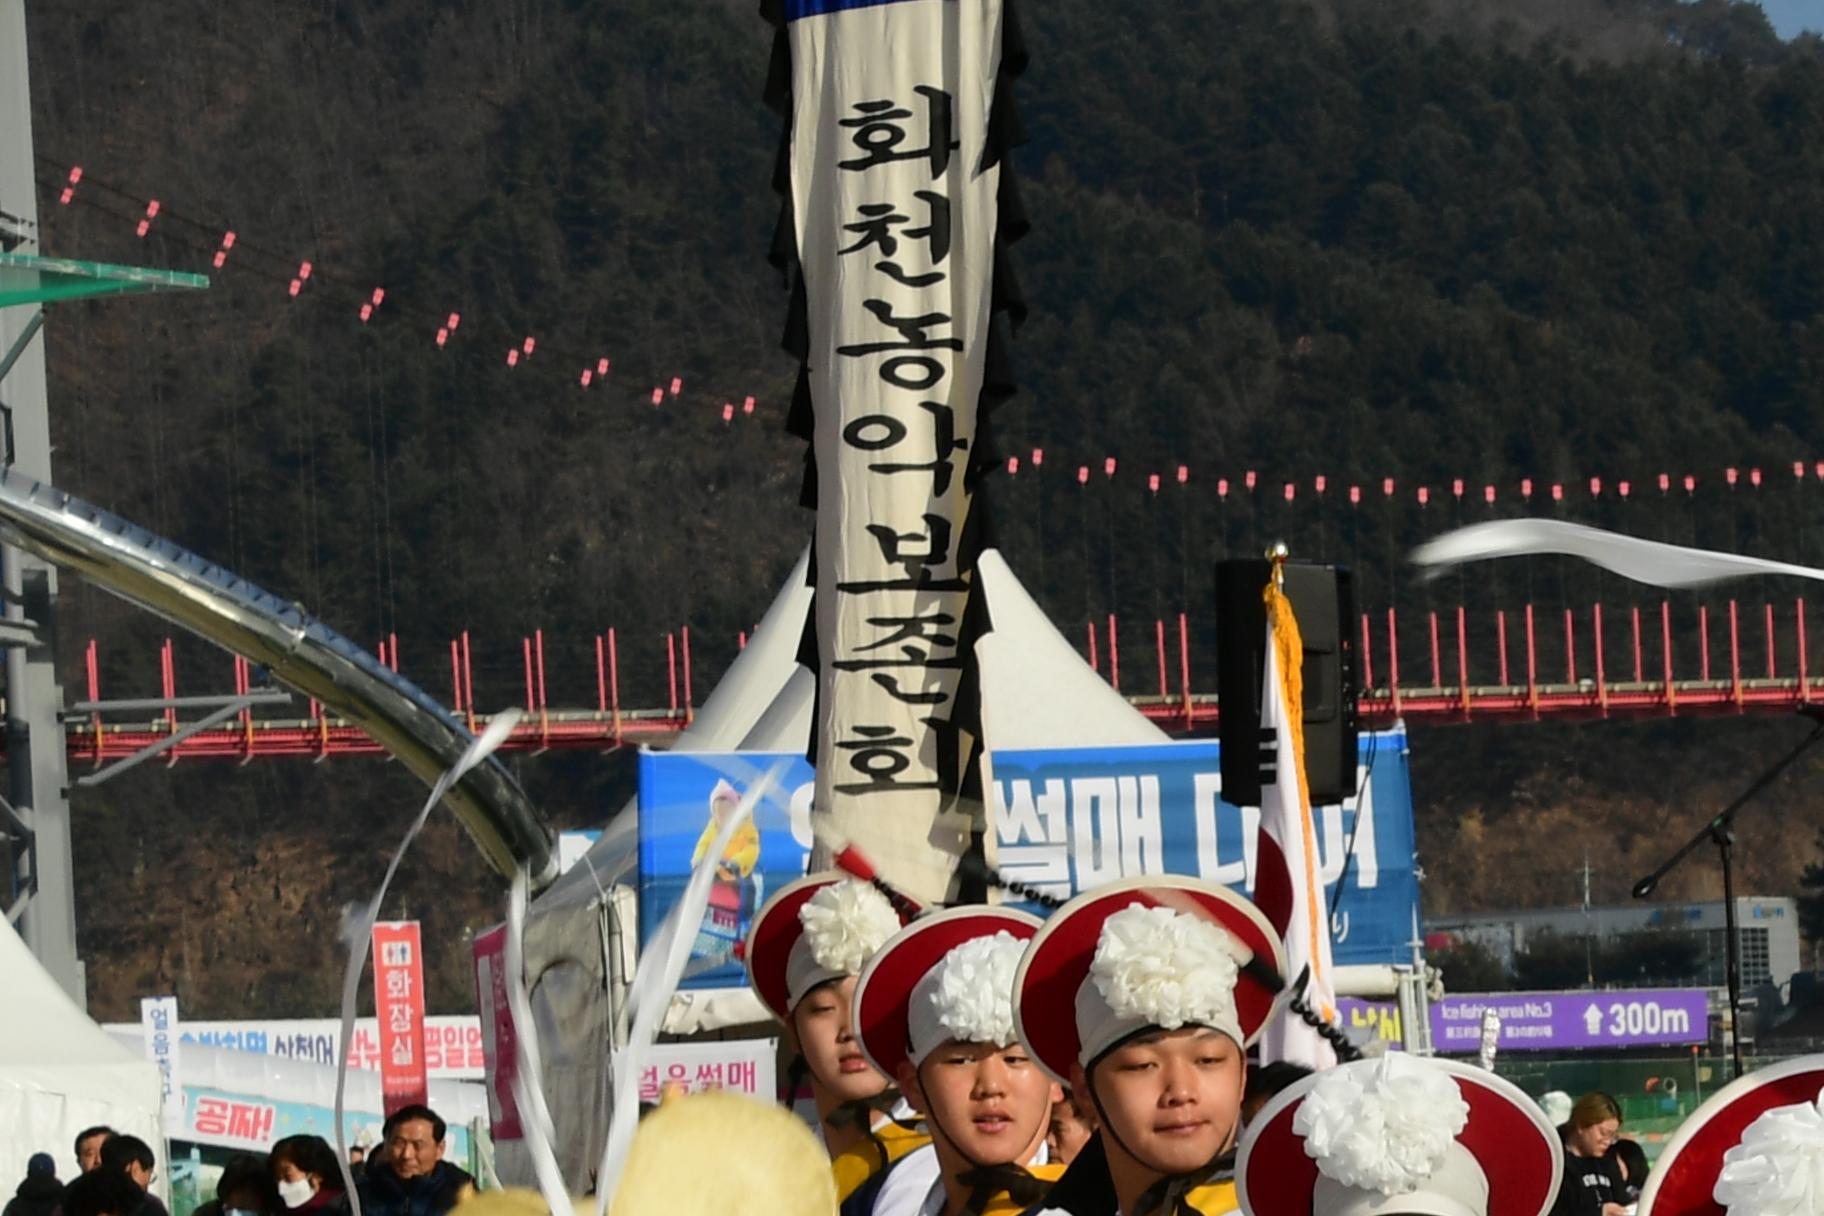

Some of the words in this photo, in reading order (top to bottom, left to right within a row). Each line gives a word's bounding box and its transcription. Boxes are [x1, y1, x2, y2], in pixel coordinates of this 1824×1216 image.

[832, 84, 969, 796] 화천농악보존회
[386, 969, 414, 1067] 화장실
[1460, 1002, 1498, 1020] fish
[1608, 1002, 1690, 1037] 300m
[195, 1097, 274, 1142] 공짜!
